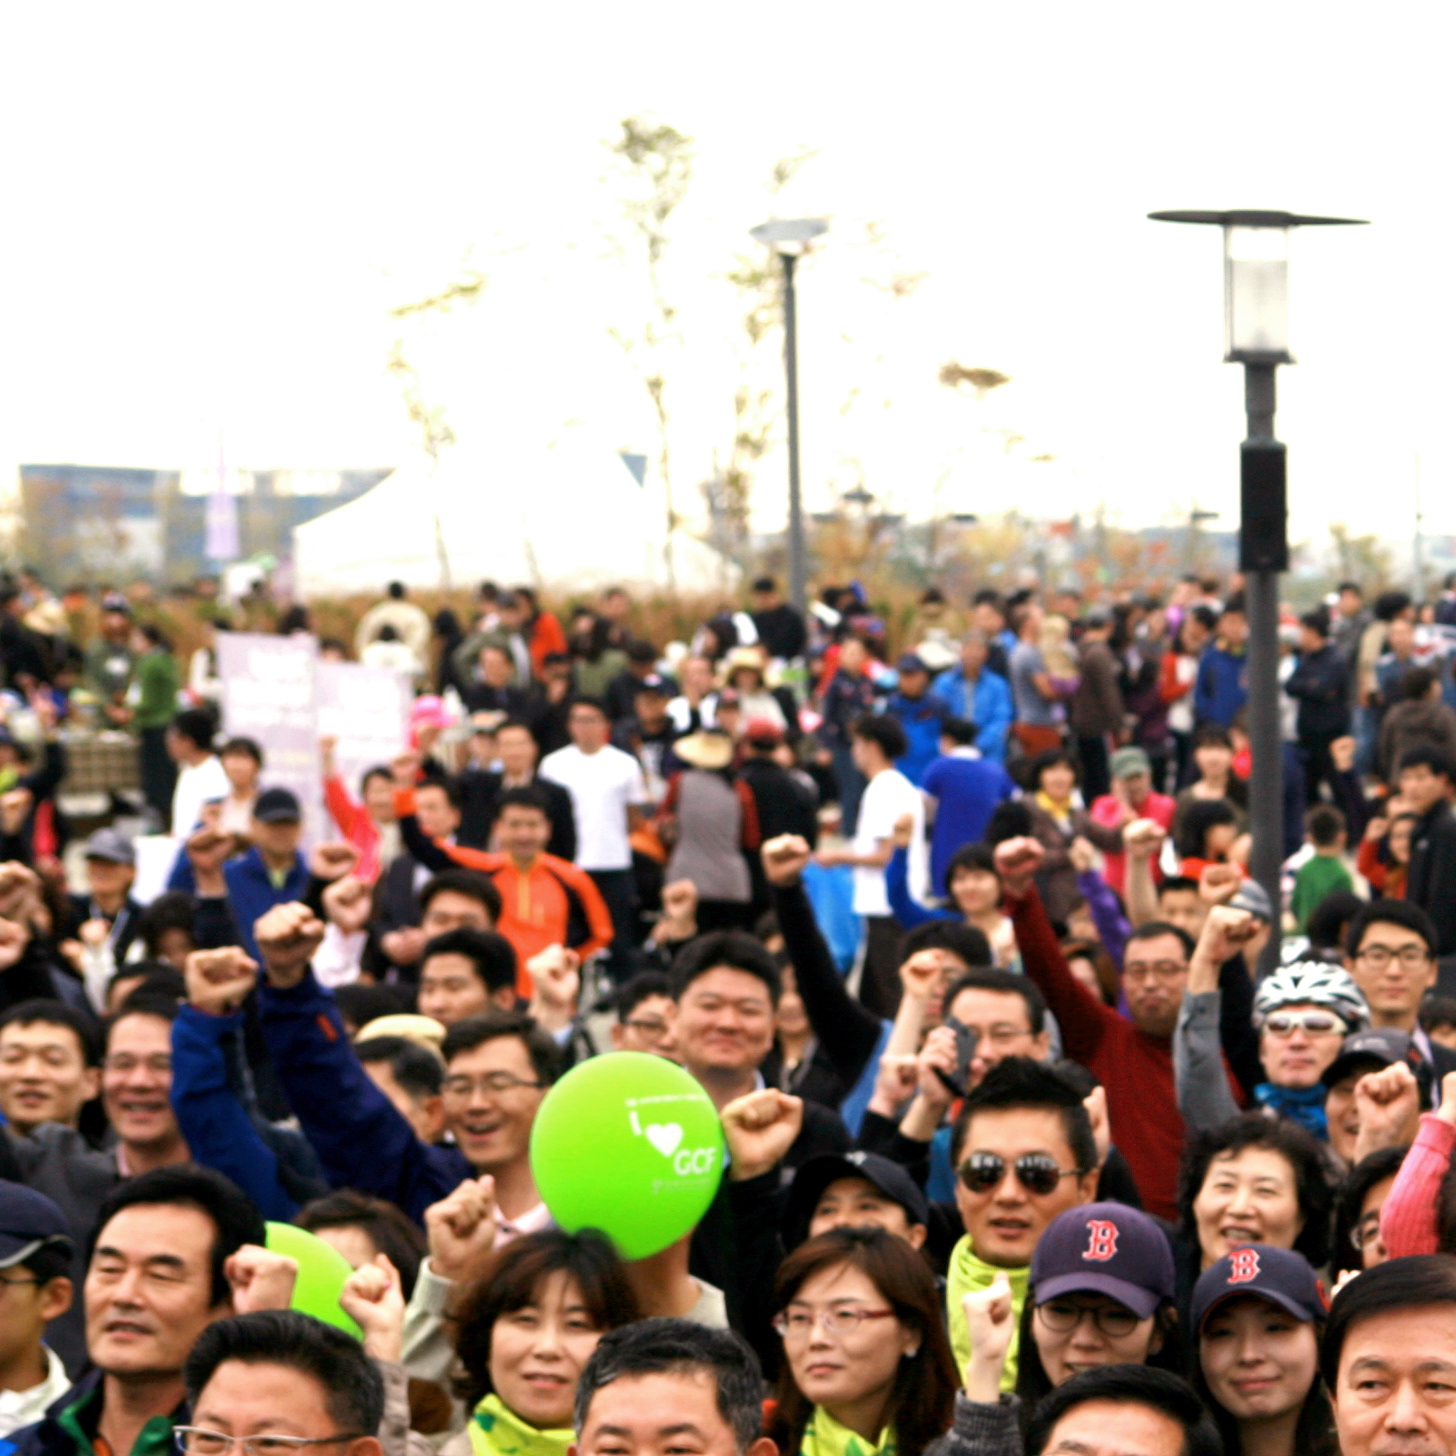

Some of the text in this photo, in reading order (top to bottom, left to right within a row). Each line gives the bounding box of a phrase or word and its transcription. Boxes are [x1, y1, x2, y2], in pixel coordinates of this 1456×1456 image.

[673, 1147, 718, 1176] GCF
[1082, 1219, 1120, 1262] B
[1226, 1247, 1261, 1285] B
